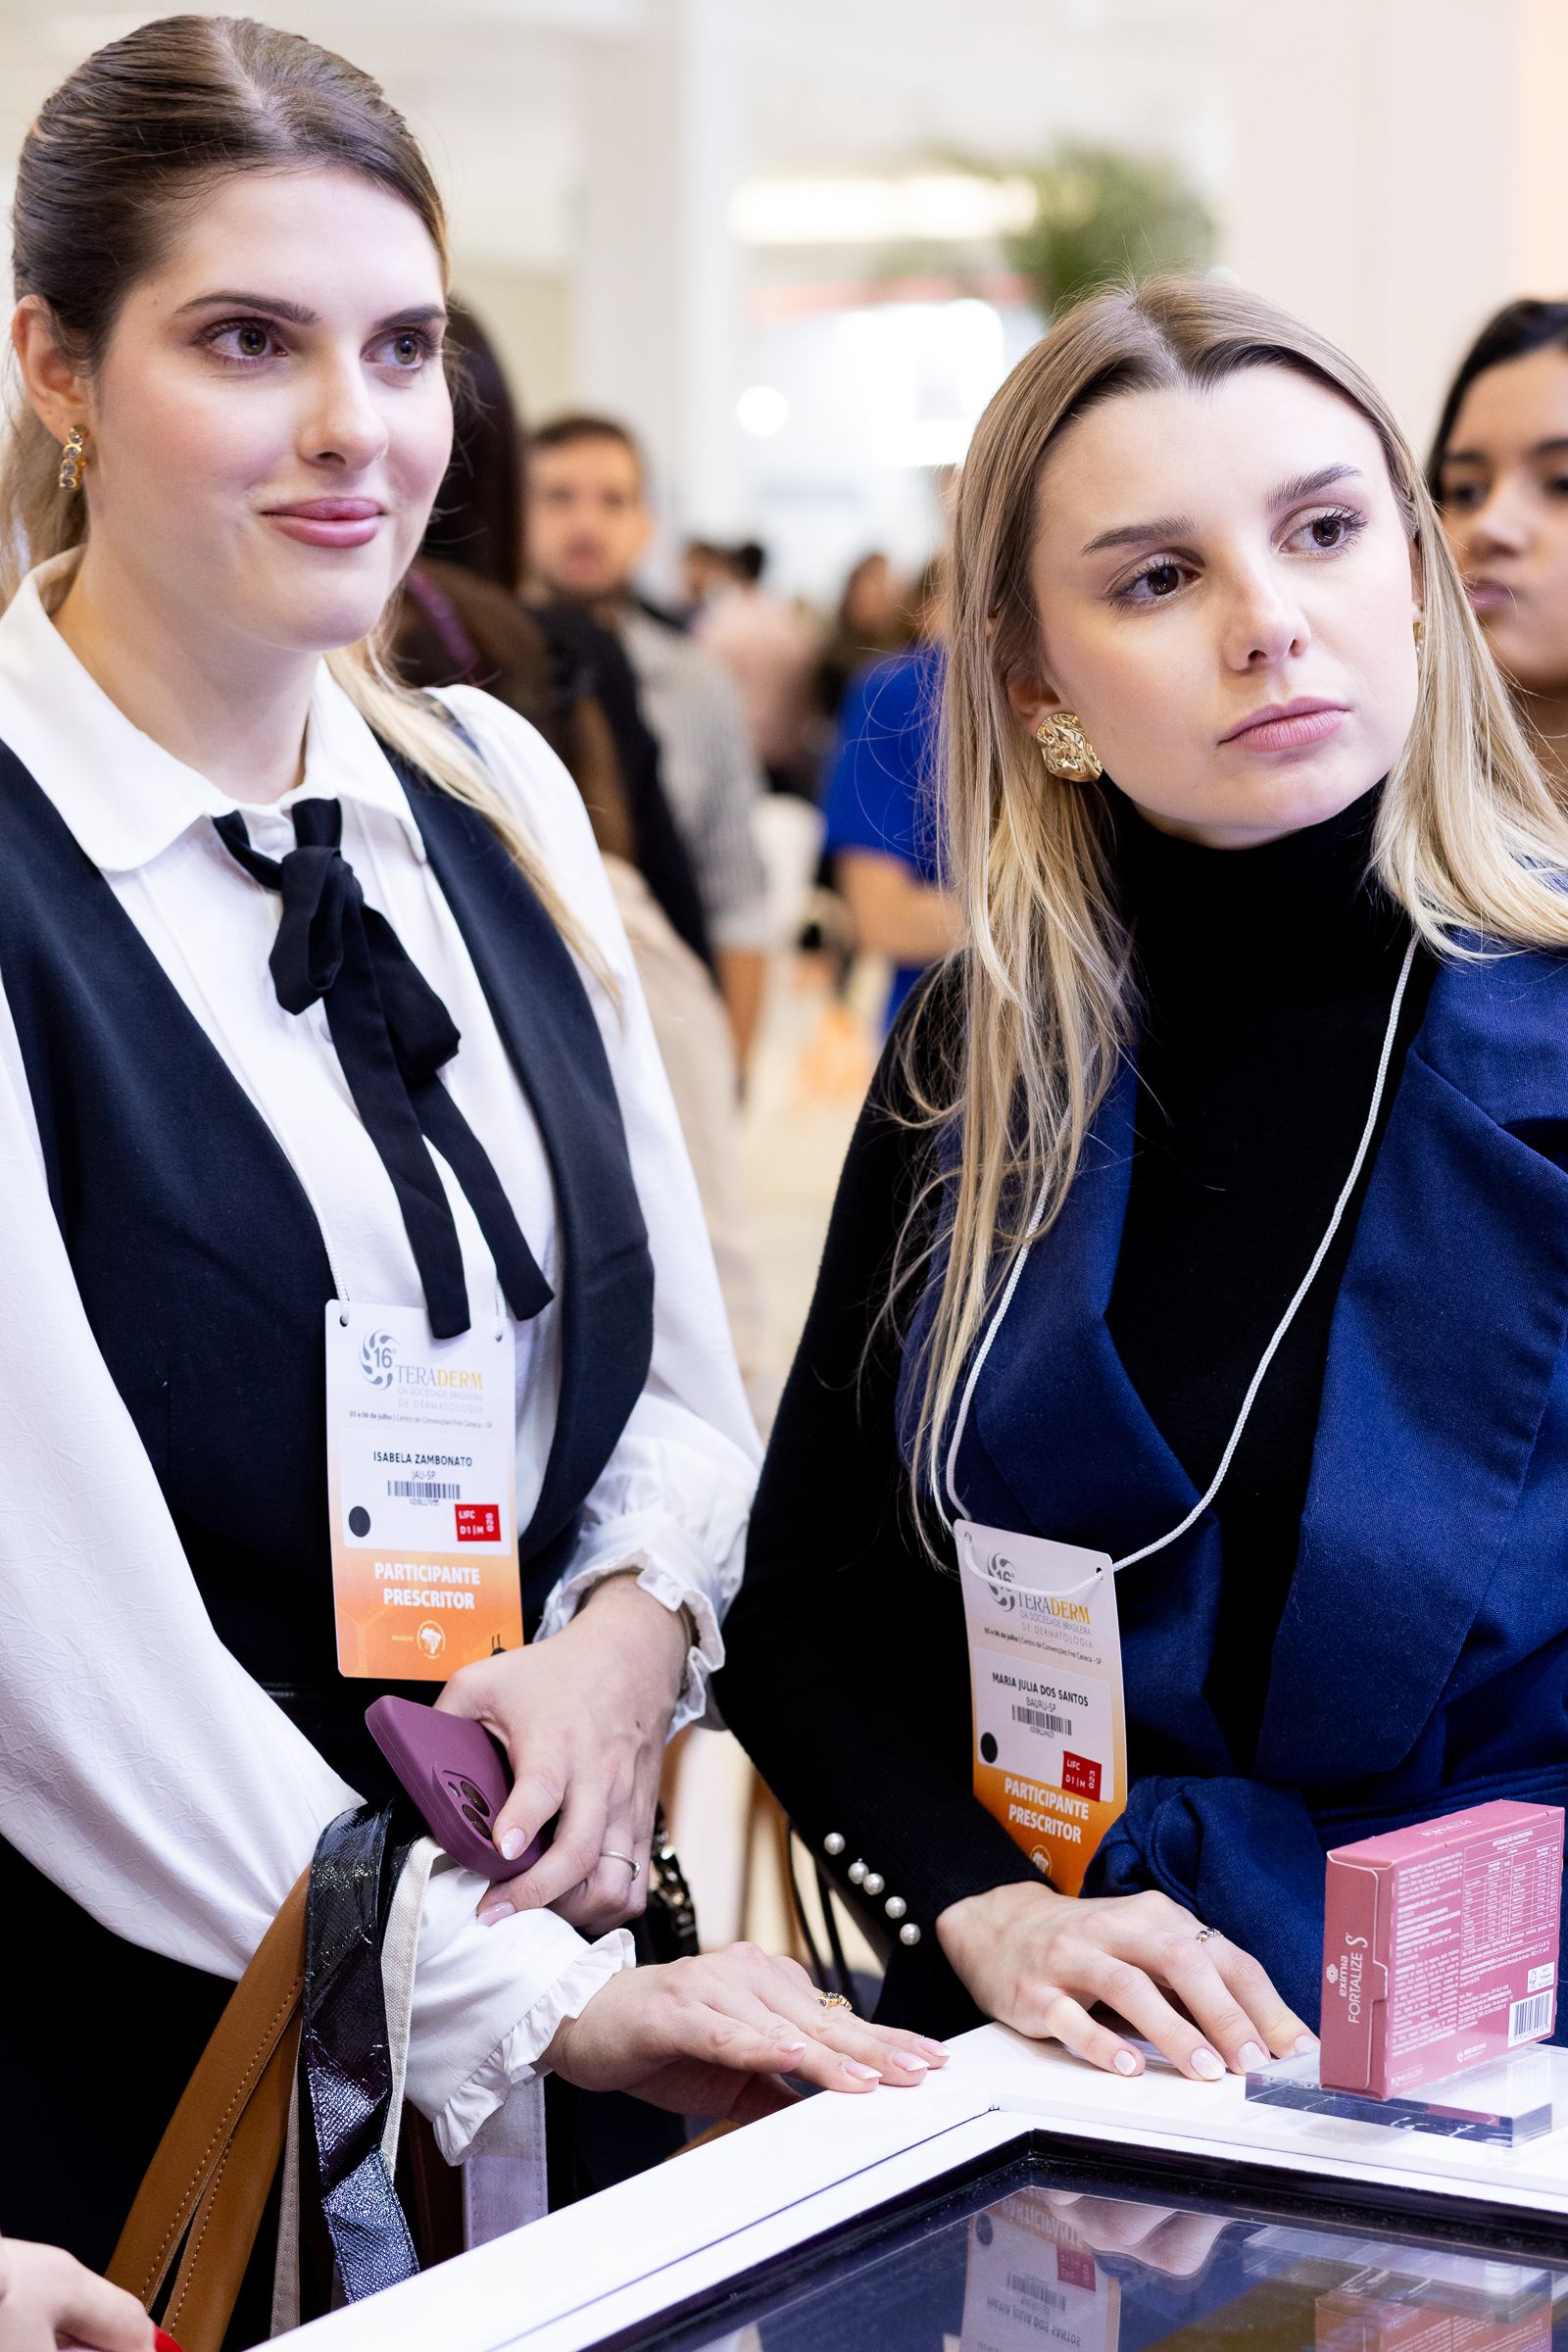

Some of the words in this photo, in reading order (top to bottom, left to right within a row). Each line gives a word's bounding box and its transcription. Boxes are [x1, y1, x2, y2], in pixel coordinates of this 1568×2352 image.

[395, 1365, 483, 1391] TERADERM
[373, 1451, 412, 1464] ISABELA
[415, 1453, 472, 1467] ZAMBONATO
[373, 1562, 480, 1585] PARTICIPANTE
[383, 1588, 475, 1609] PRESCRITOR
[1019, 1592, 1091, 1625] TERADERM
[1034, 1626, 1094, 1648] DERMATOLOGIA
[992, 1672, 1017, 1688] MARIA
[1018, 1679, 1038, 1694] JULIA
[1040, 1685, 1055, 1698] DOS
[1057, 1690, 1089, 1707] SANTOS
[1026, 1696, 1056, 1712] BAURU-SP
[1004, 1777, 1089, 1820] PARTICIPANTE
[1008, 1803, 1082, 1843] PRESCRITOR
[1348, 1952, 1363, 2024] FORTALIZE
